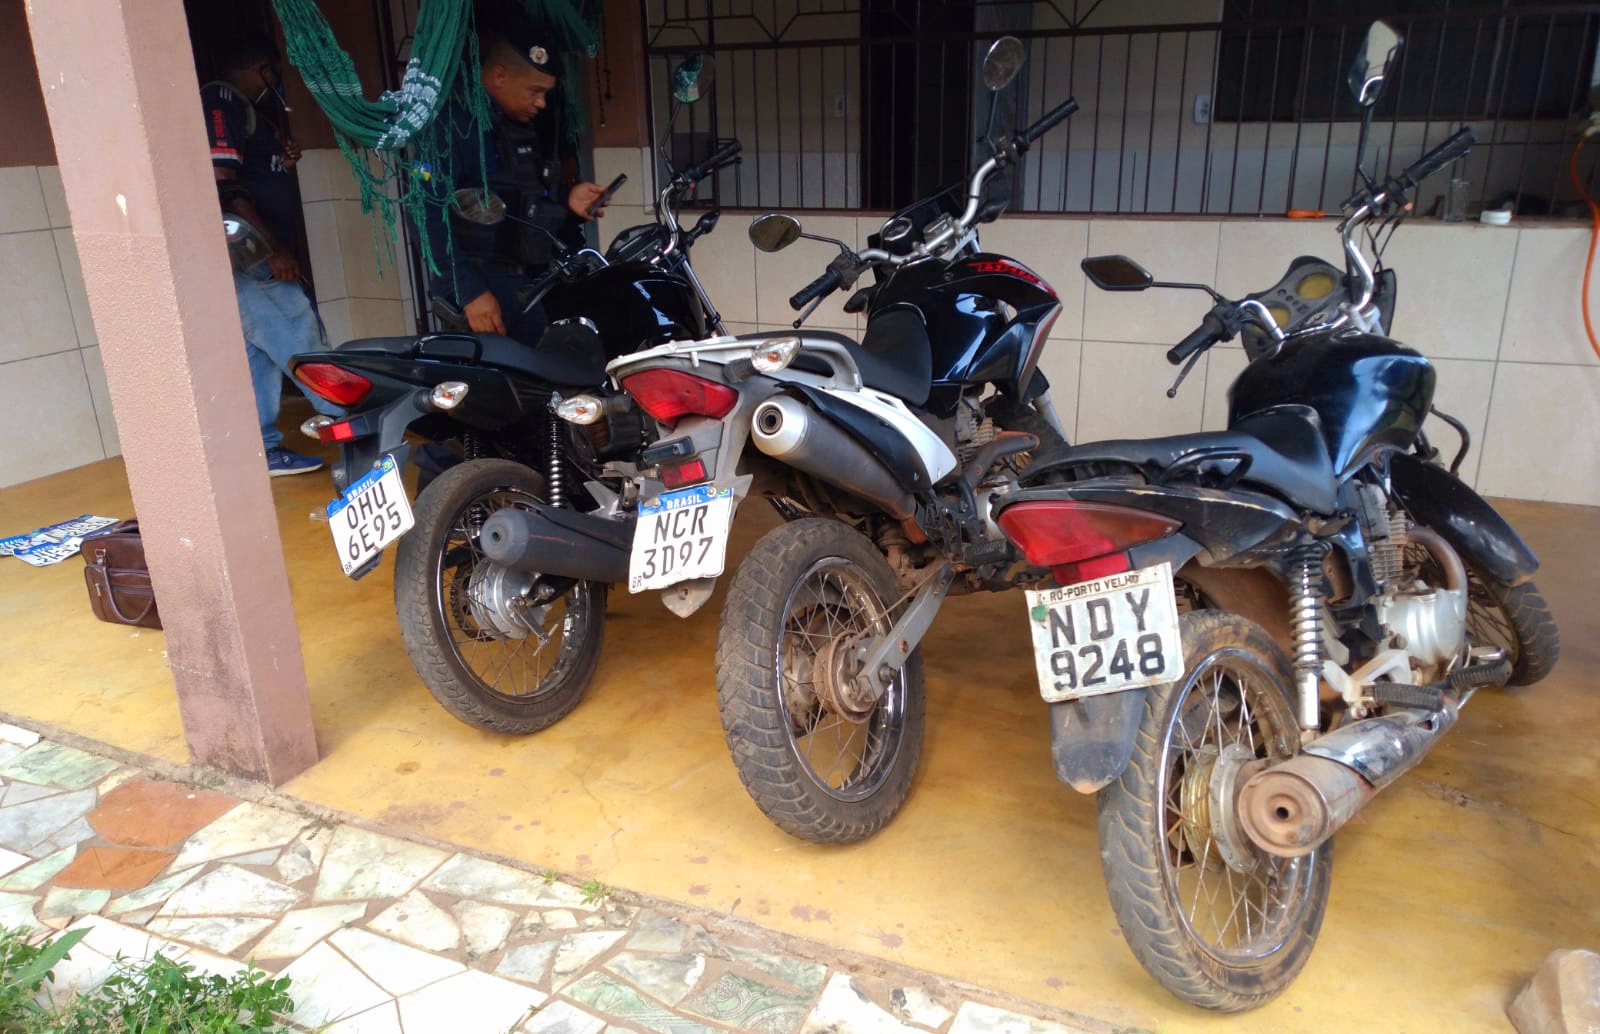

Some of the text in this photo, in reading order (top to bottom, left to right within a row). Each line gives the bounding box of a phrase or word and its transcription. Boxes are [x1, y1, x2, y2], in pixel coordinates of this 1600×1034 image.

[347, 477, 376, 501] BRASIL
[666, 494, 703, 510] BRASIL
[348, 501, 402, 561] 6E95
[653, 505, 709, 545] NCR
[642, 536, 714, 580] 3D97
[632, 575, 643, 589] BR
[1049, 574, 1141, 602] RO-PORTO VELHO
[1050, 588, 1150, 649] NDY
[1050, 632, 1166, 692] 9248
